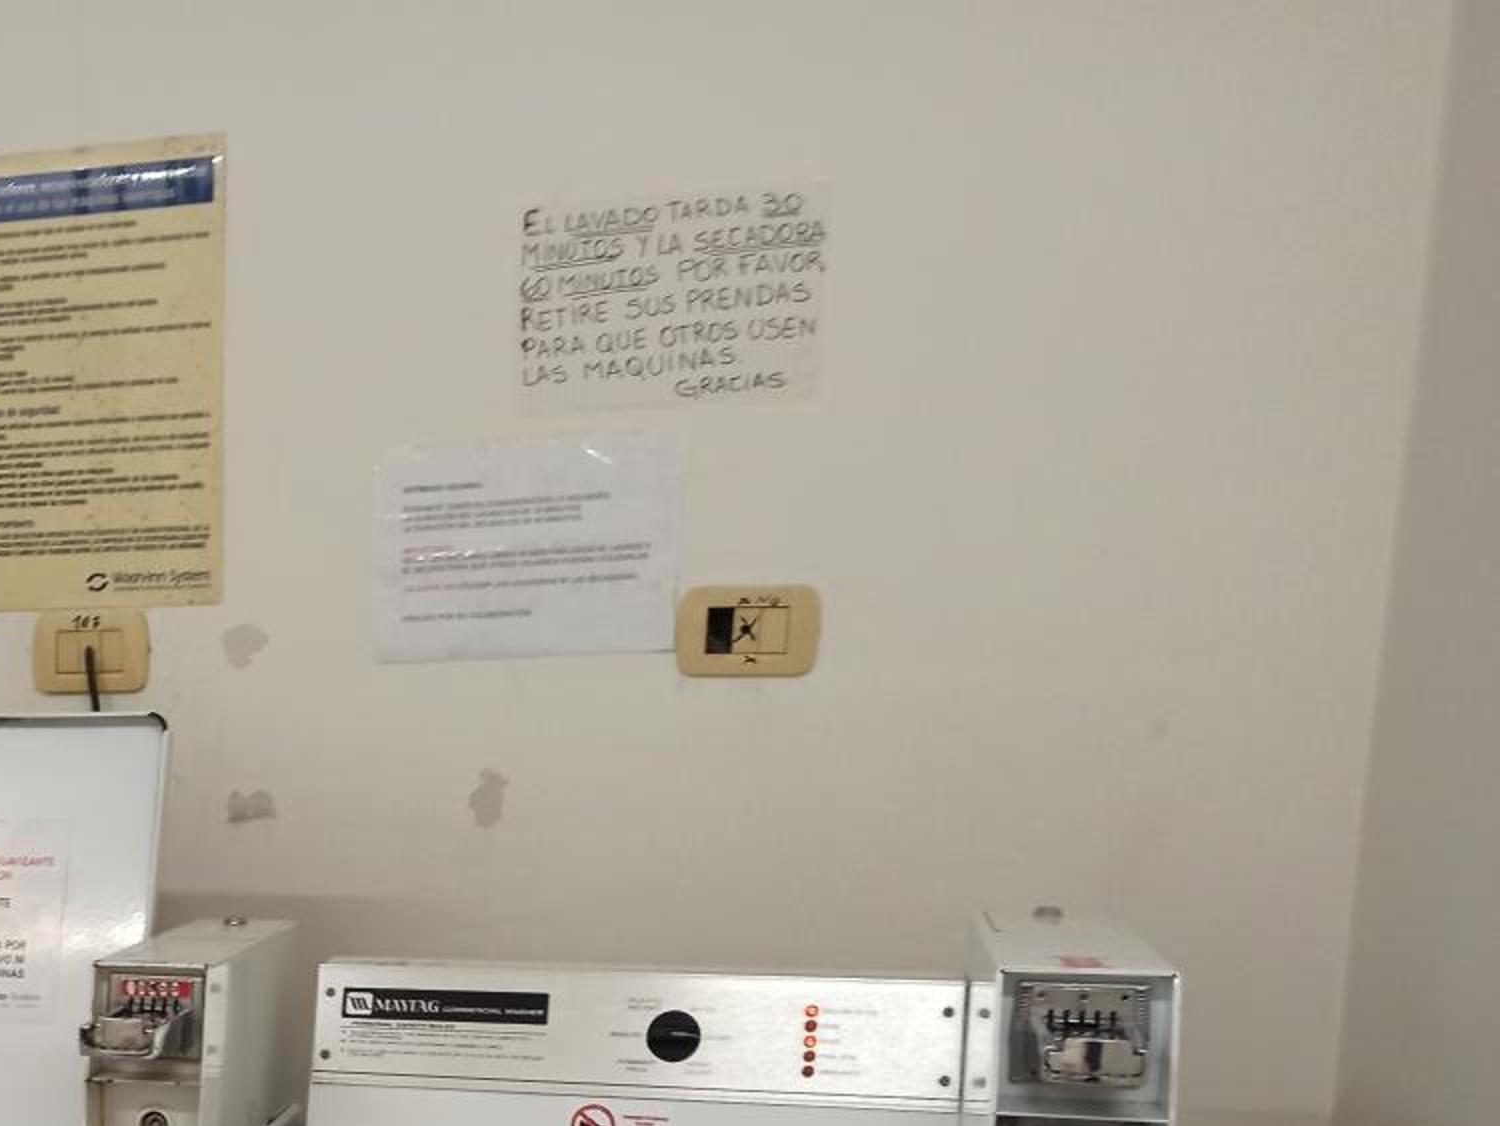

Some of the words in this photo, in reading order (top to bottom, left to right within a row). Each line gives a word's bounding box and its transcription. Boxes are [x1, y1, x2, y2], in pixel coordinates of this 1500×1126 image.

[523, 208, 555, 236] EL
[564, 206, 659, 235] LAVADO
[664, 196, 749, 221] TARDA
[520, 239, 624, 267] MINUTOS
[636, 236, 648, 258] Y
[657, 234, 682, 256] LA
[694, 220, 826, 251] SECADORA
[557, 265, 660, 294] MINUTOS
[676, 258, 729, 283] POR
[739, 251, 827, 275] FAVOR
[520, 301, 610, 332] RETIRE
[625, 294, 676, 320] SUS
[686, 282, 813, 314] PRENDAS
[520, 337, 584, 359] PARA
[596, 328, 648, 353] QUE
[659, 321, 739, 348] OTROS
[747, 317, 819, 341] USEN
[522, 364, 567, 387] LAS
[582, 347, 737, 380] MAQUINAS
[675, 371, 788, 399] GRACIAS
[373, 997, 440, 1014] MAYTAG
